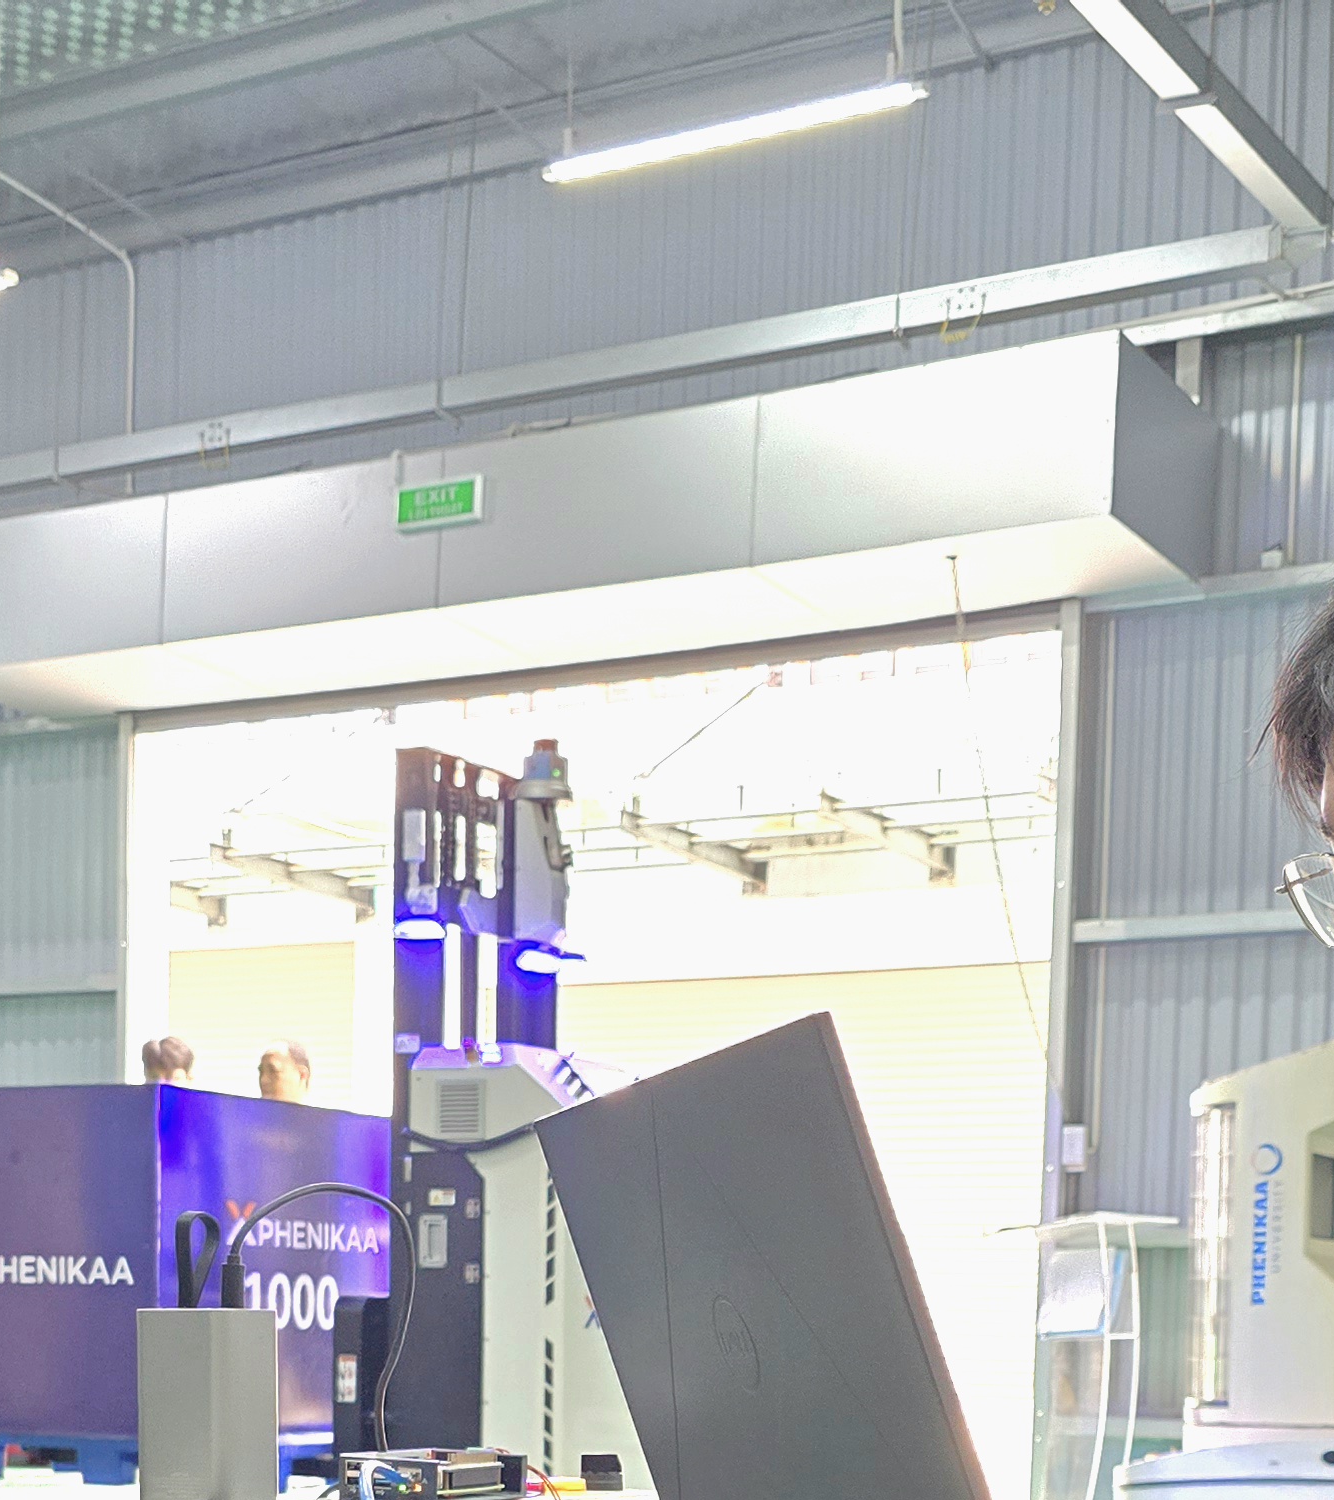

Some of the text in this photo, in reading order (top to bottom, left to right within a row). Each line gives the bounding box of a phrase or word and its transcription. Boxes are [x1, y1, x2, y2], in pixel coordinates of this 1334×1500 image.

[414, 485, 457, 506] EXIT
[1252, 1181, 1269, 1305] PHENIKAA
[244, 1272, 339, 1331] 1000
